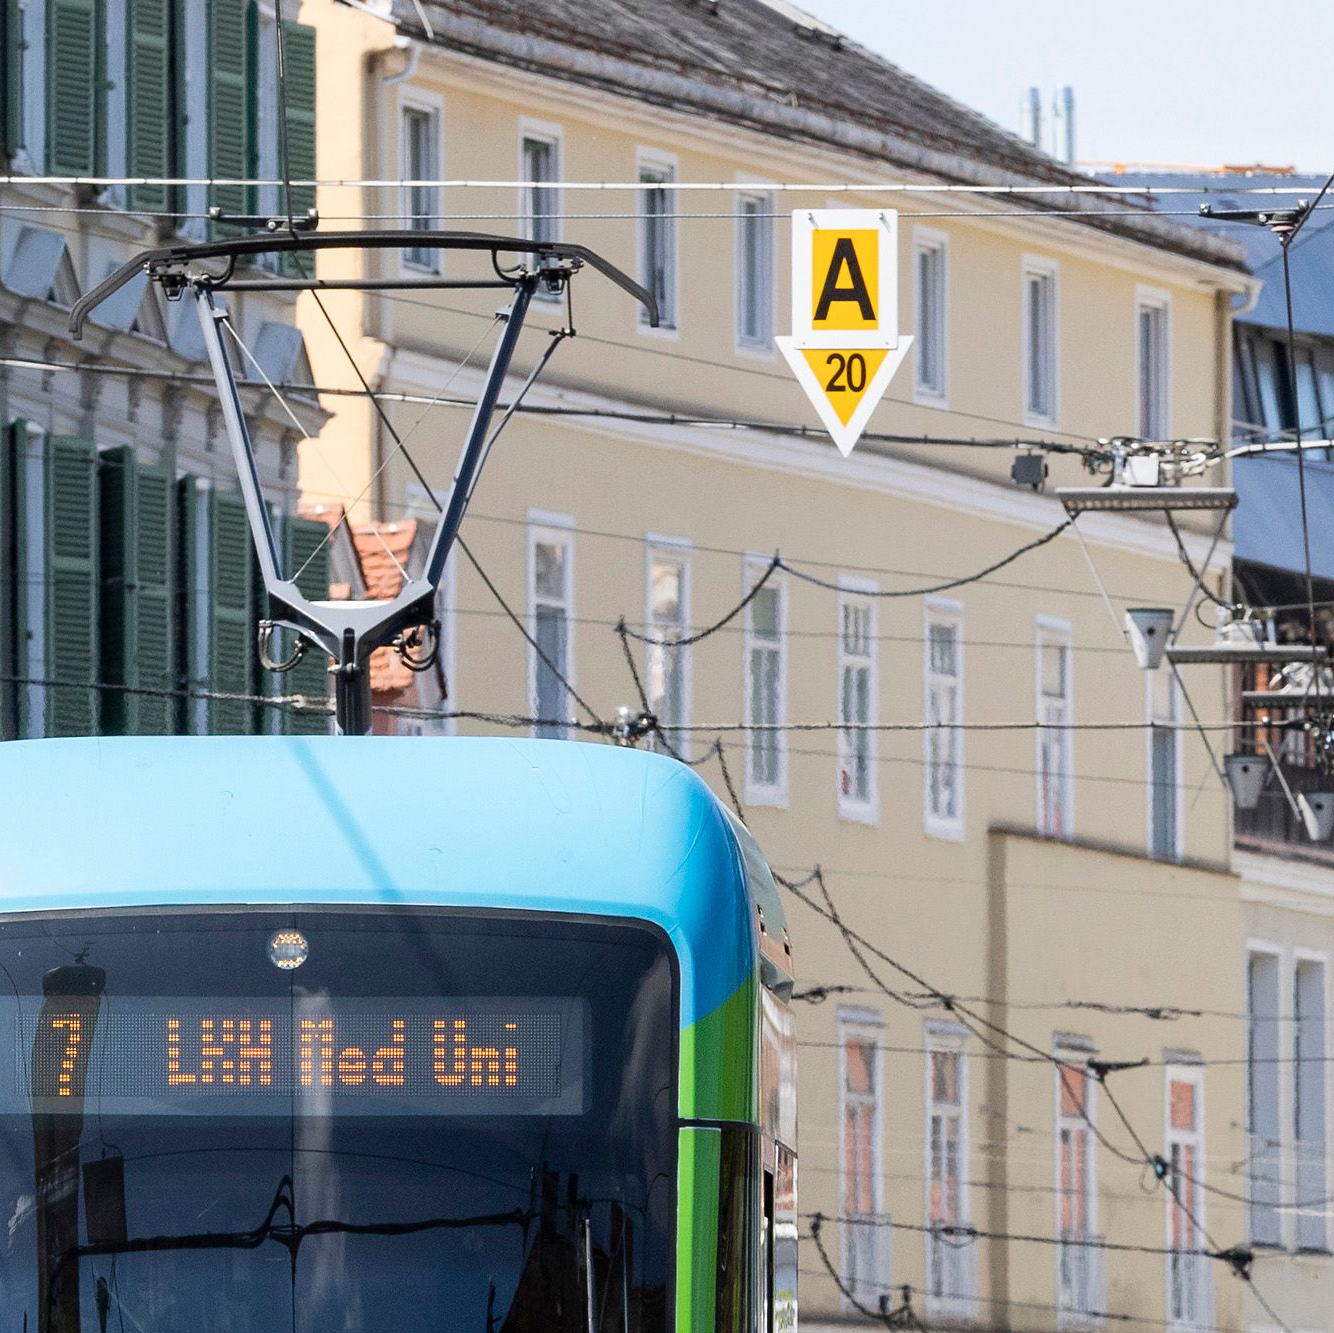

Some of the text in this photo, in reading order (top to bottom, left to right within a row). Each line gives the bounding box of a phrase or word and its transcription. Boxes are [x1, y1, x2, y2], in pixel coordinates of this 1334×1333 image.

[813, 237, 877, 321] A
[825, 352, 867, 393] 20
[52, 1012, 81, 1097] 7
[300, 1019, 405, 1086] Med
[433, 1019, 518, 1086] Uni
